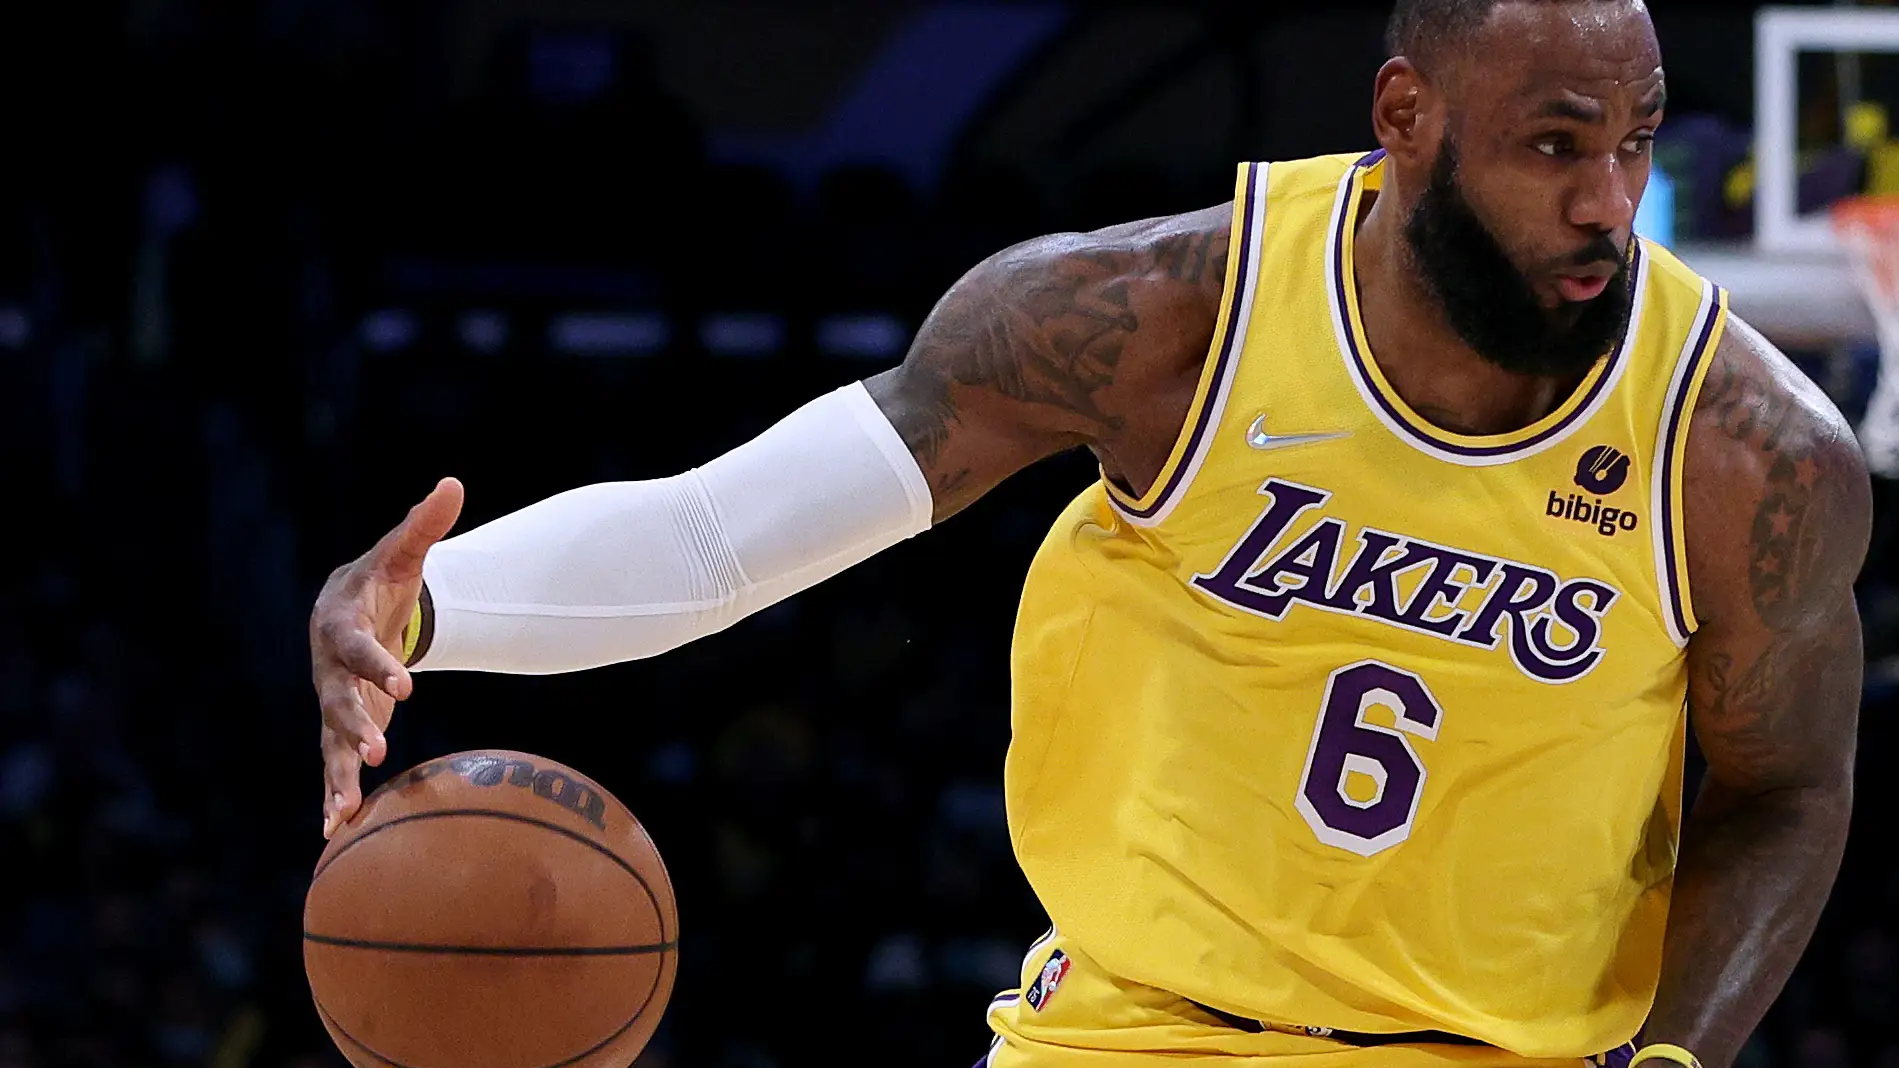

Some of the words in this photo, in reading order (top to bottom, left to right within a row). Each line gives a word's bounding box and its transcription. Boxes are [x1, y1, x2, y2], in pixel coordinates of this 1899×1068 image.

[1190, 477, 1621, 685] LAKERS
[1545, 490, 1638, 537] bibigo
[1294, 658, 1444, 858] 6
